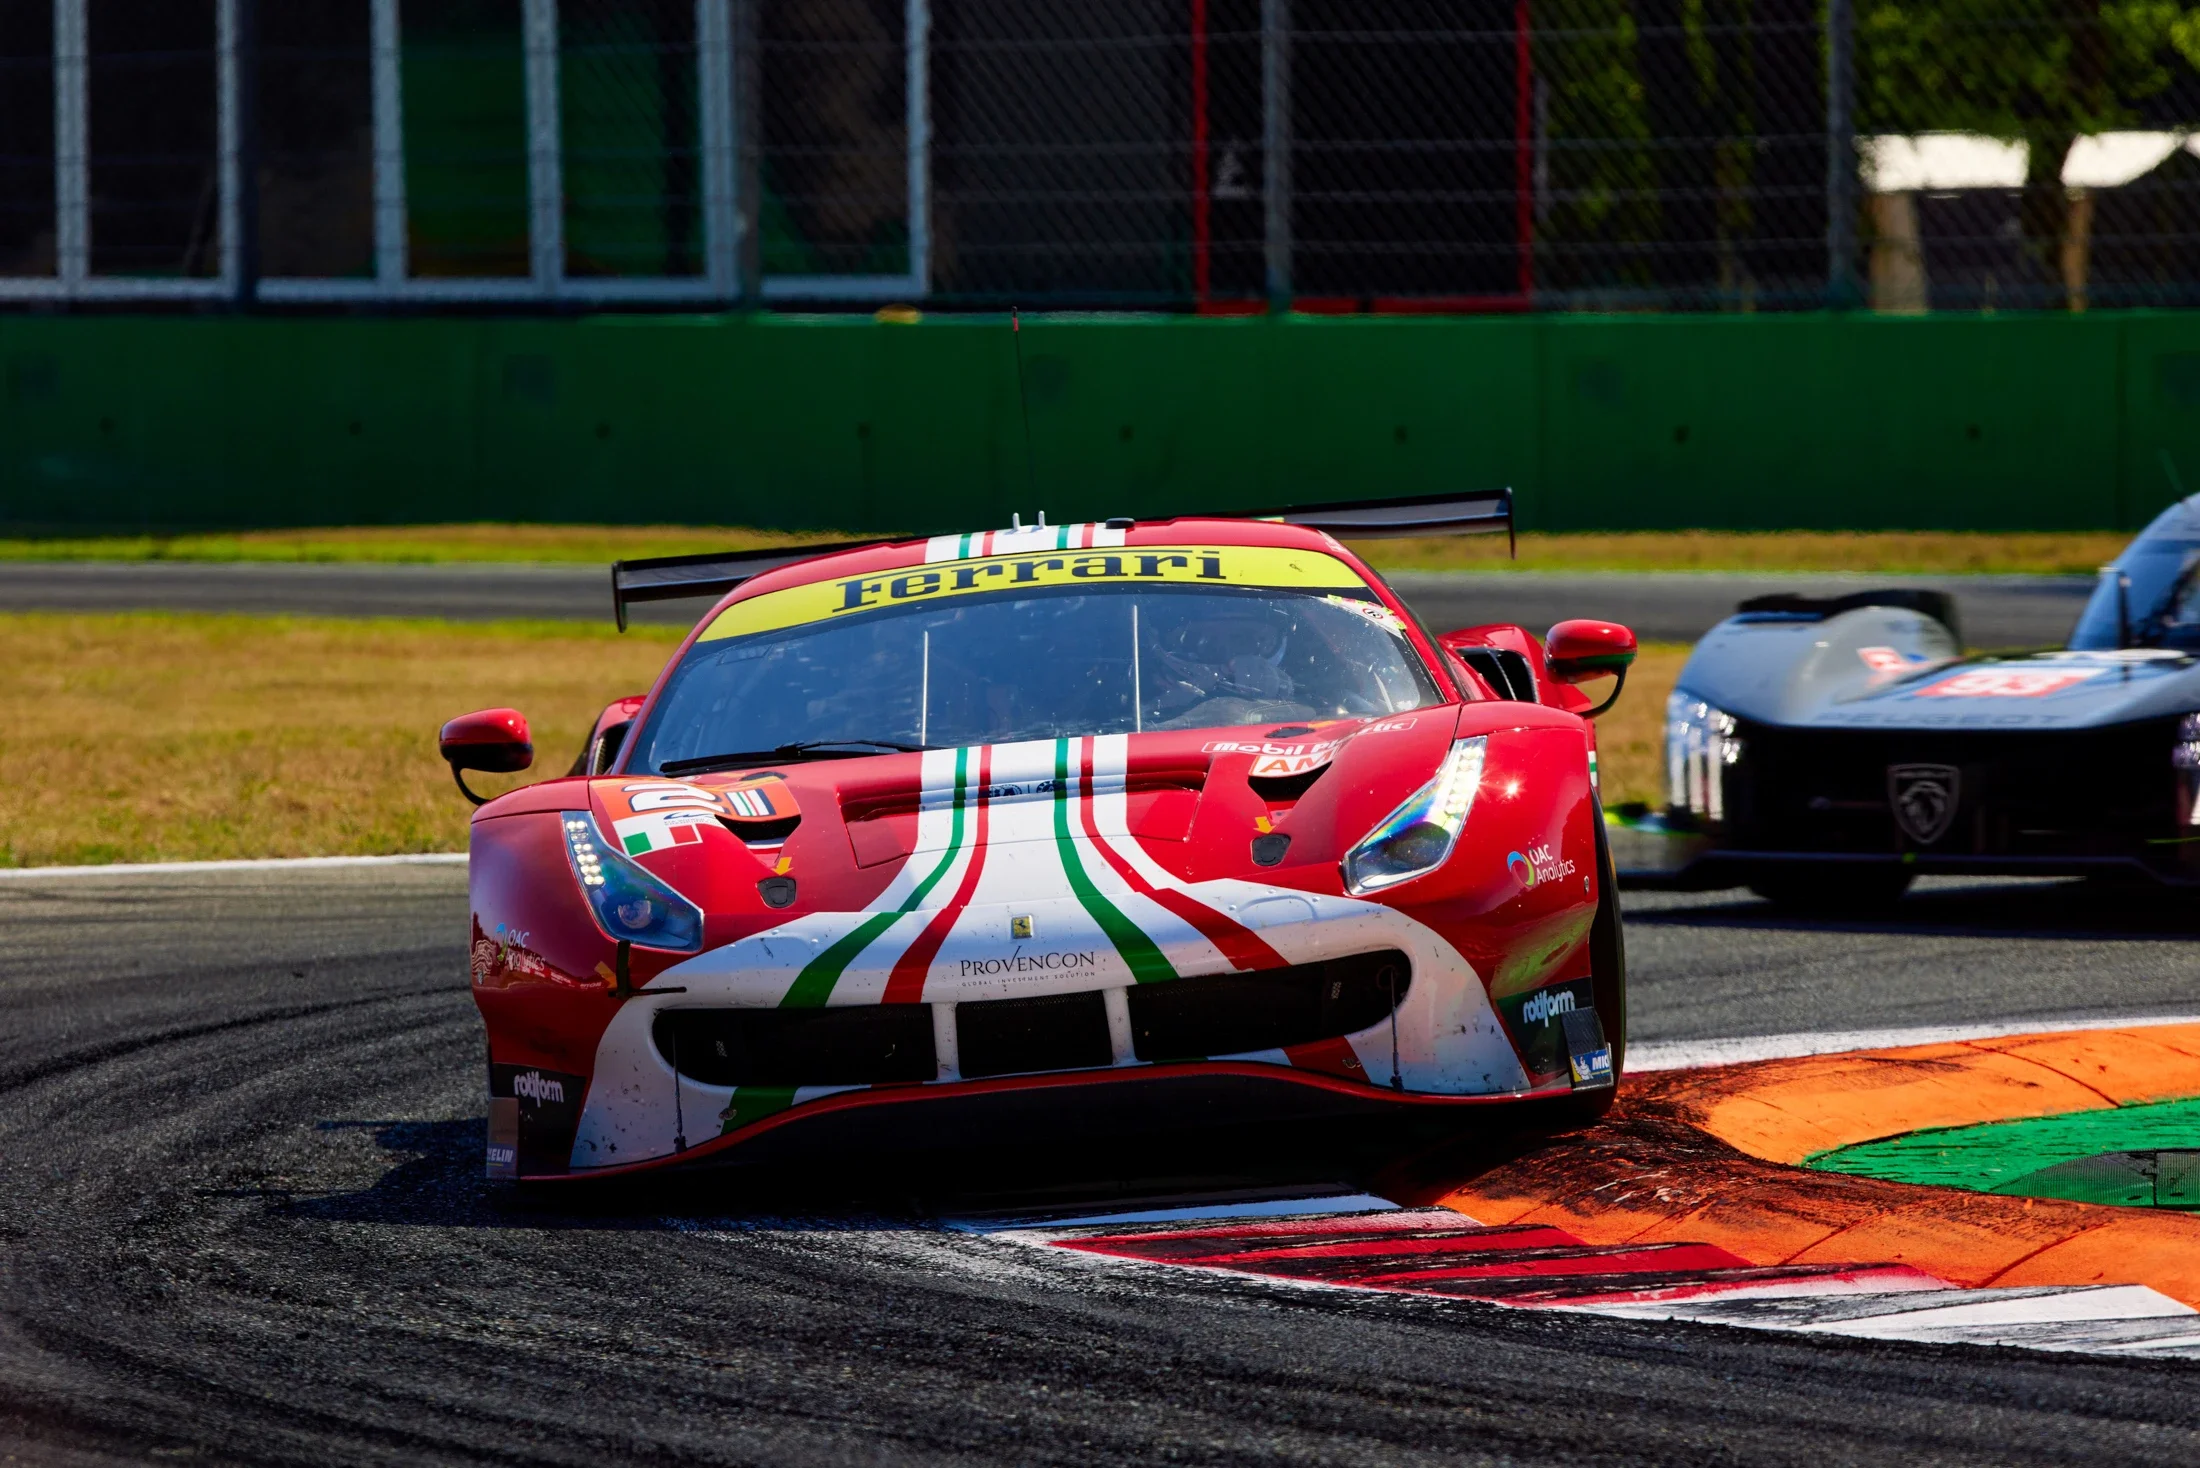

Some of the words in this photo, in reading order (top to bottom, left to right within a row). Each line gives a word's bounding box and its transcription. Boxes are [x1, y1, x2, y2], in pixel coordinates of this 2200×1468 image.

[832, 549, 1227, 613] Ferrari
[1212, 742, 1304, 755] Mobil
[1528, 844, 1553, 865] OAC
[1536, 859, 1576, 884] Analytics
[508, 929, 530, 948] OAC
[1523, 989, 1576, 1028] rotiform
[514, 1070, 564, 1107] rotiform
